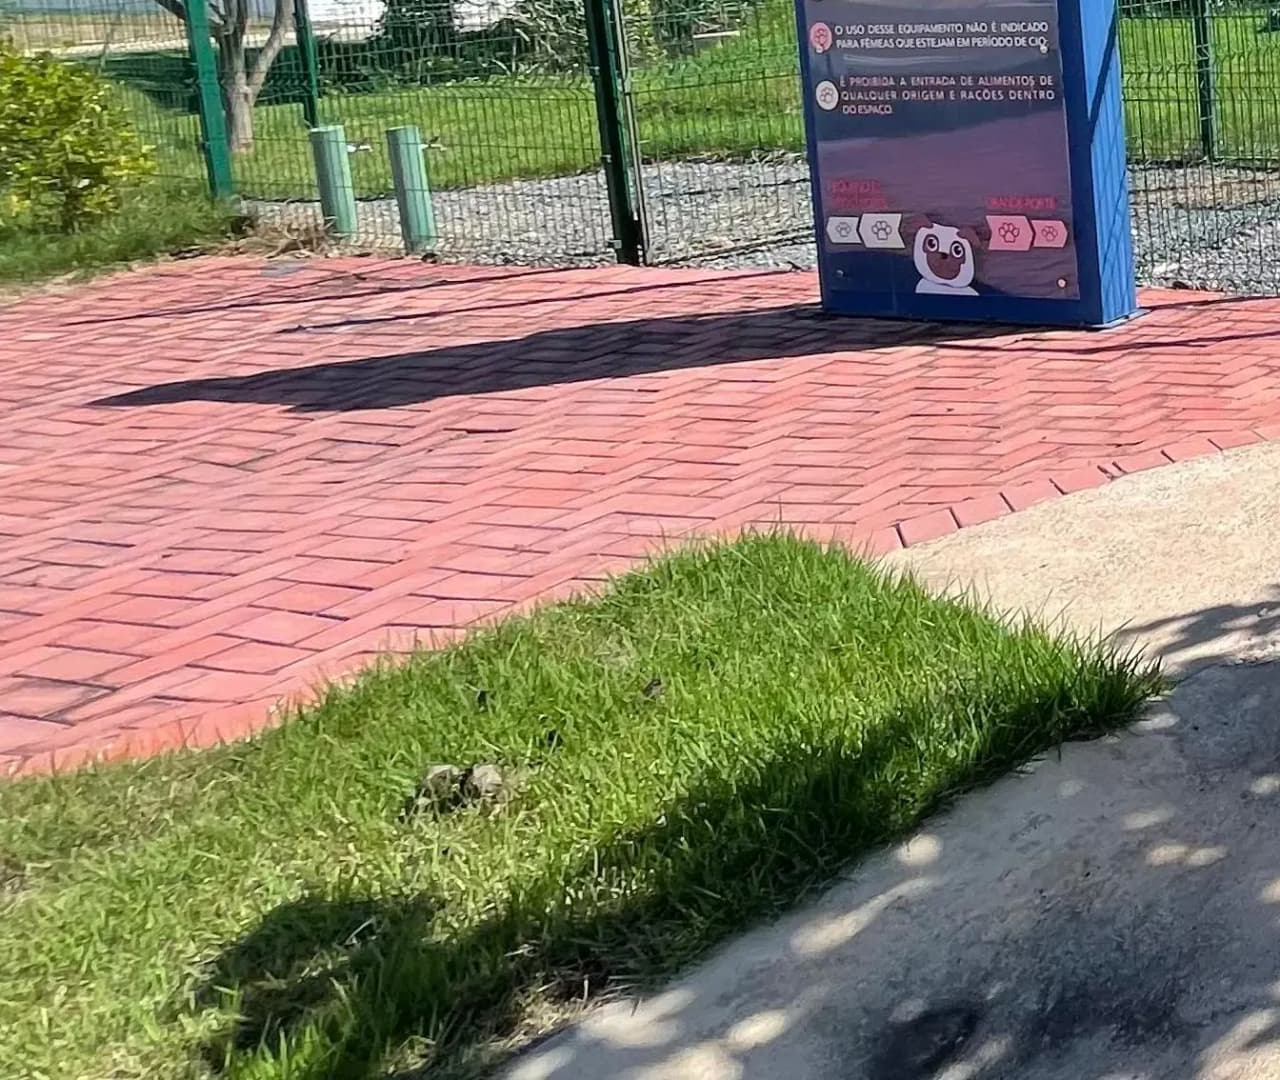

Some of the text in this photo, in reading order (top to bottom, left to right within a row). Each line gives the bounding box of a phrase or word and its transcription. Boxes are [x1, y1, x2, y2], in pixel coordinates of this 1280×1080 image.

[834, 20, 1048, 35] O USO DESSE EQUIPAMENTO NÃO É INDICADO
[836, 38, 859, 49] PARA
[860, 37, 894, 49] FÊMEAS
[895, 38, 915, 49] QUE
[916, 37, 955, 48] ESTEJAM
[956, 37, 970, 48] EM
[972, 35, 1013, 47] PERÍODO
[1014, 37, 1027, 47] DE
[900, 76, 907, 86] A
[911, 76, 956, 87] ENTRADA
[960, 75, 974, 86] DE
[978, 75, 1035, 86] ALIMENTOS
[1040, 75, 1054, 86] DE
[841, 90, 897, 101] QUALQUER
[902, 90, 945, 100] ORIGEM
[949, 90, 955, 100] E
[1008, 89, 1055, 100] DENTRO
[842, 104, 857, 114] DO
